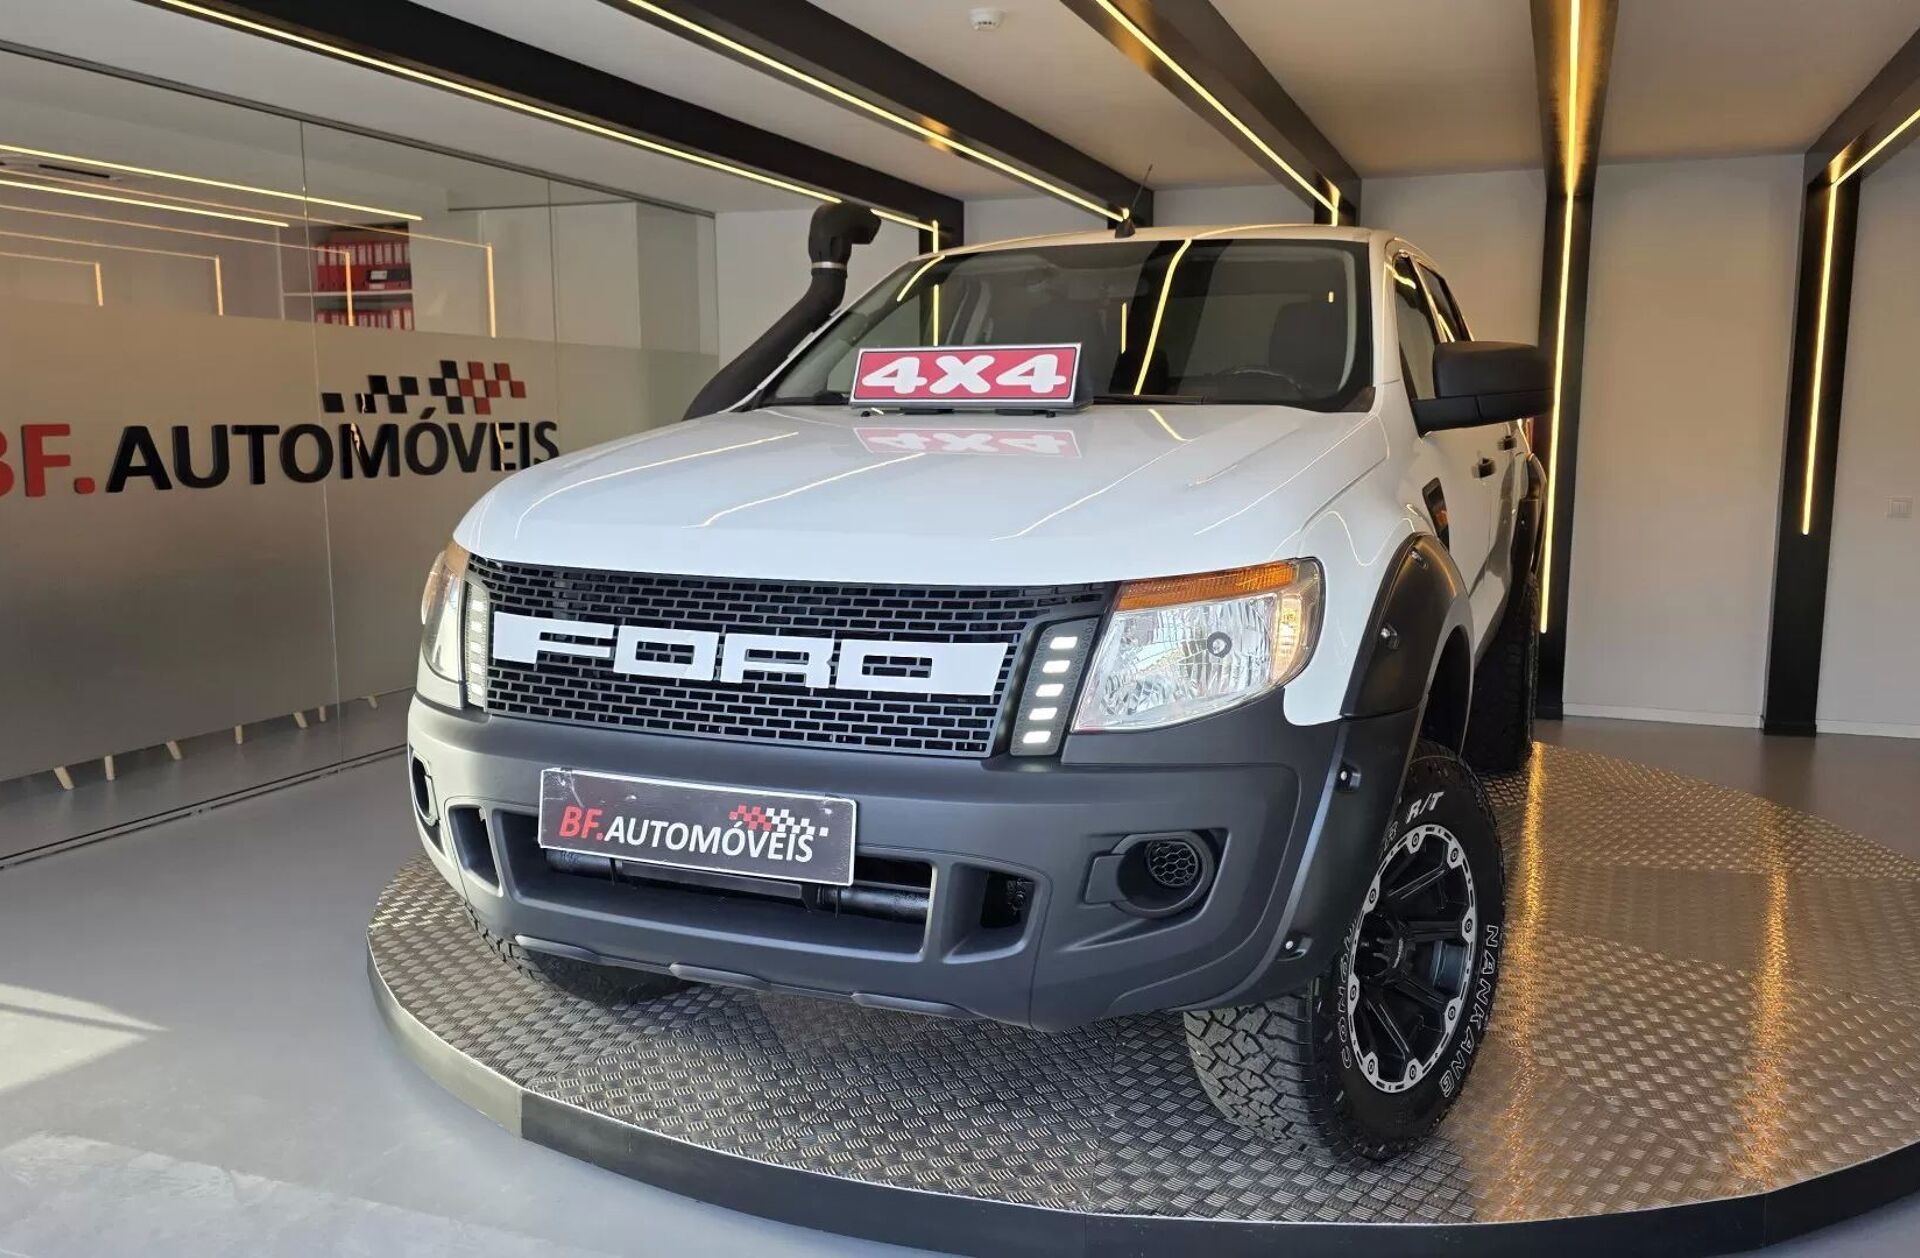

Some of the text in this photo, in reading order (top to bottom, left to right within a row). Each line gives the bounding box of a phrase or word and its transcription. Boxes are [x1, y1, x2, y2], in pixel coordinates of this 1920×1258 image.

[861, 353, 1067, 395] 4X4
[492, 611, 1009, 697] FORD
[1406, 791, 1444, 823] R/T
[1439, 924, 1499, 1098] NANKANG
